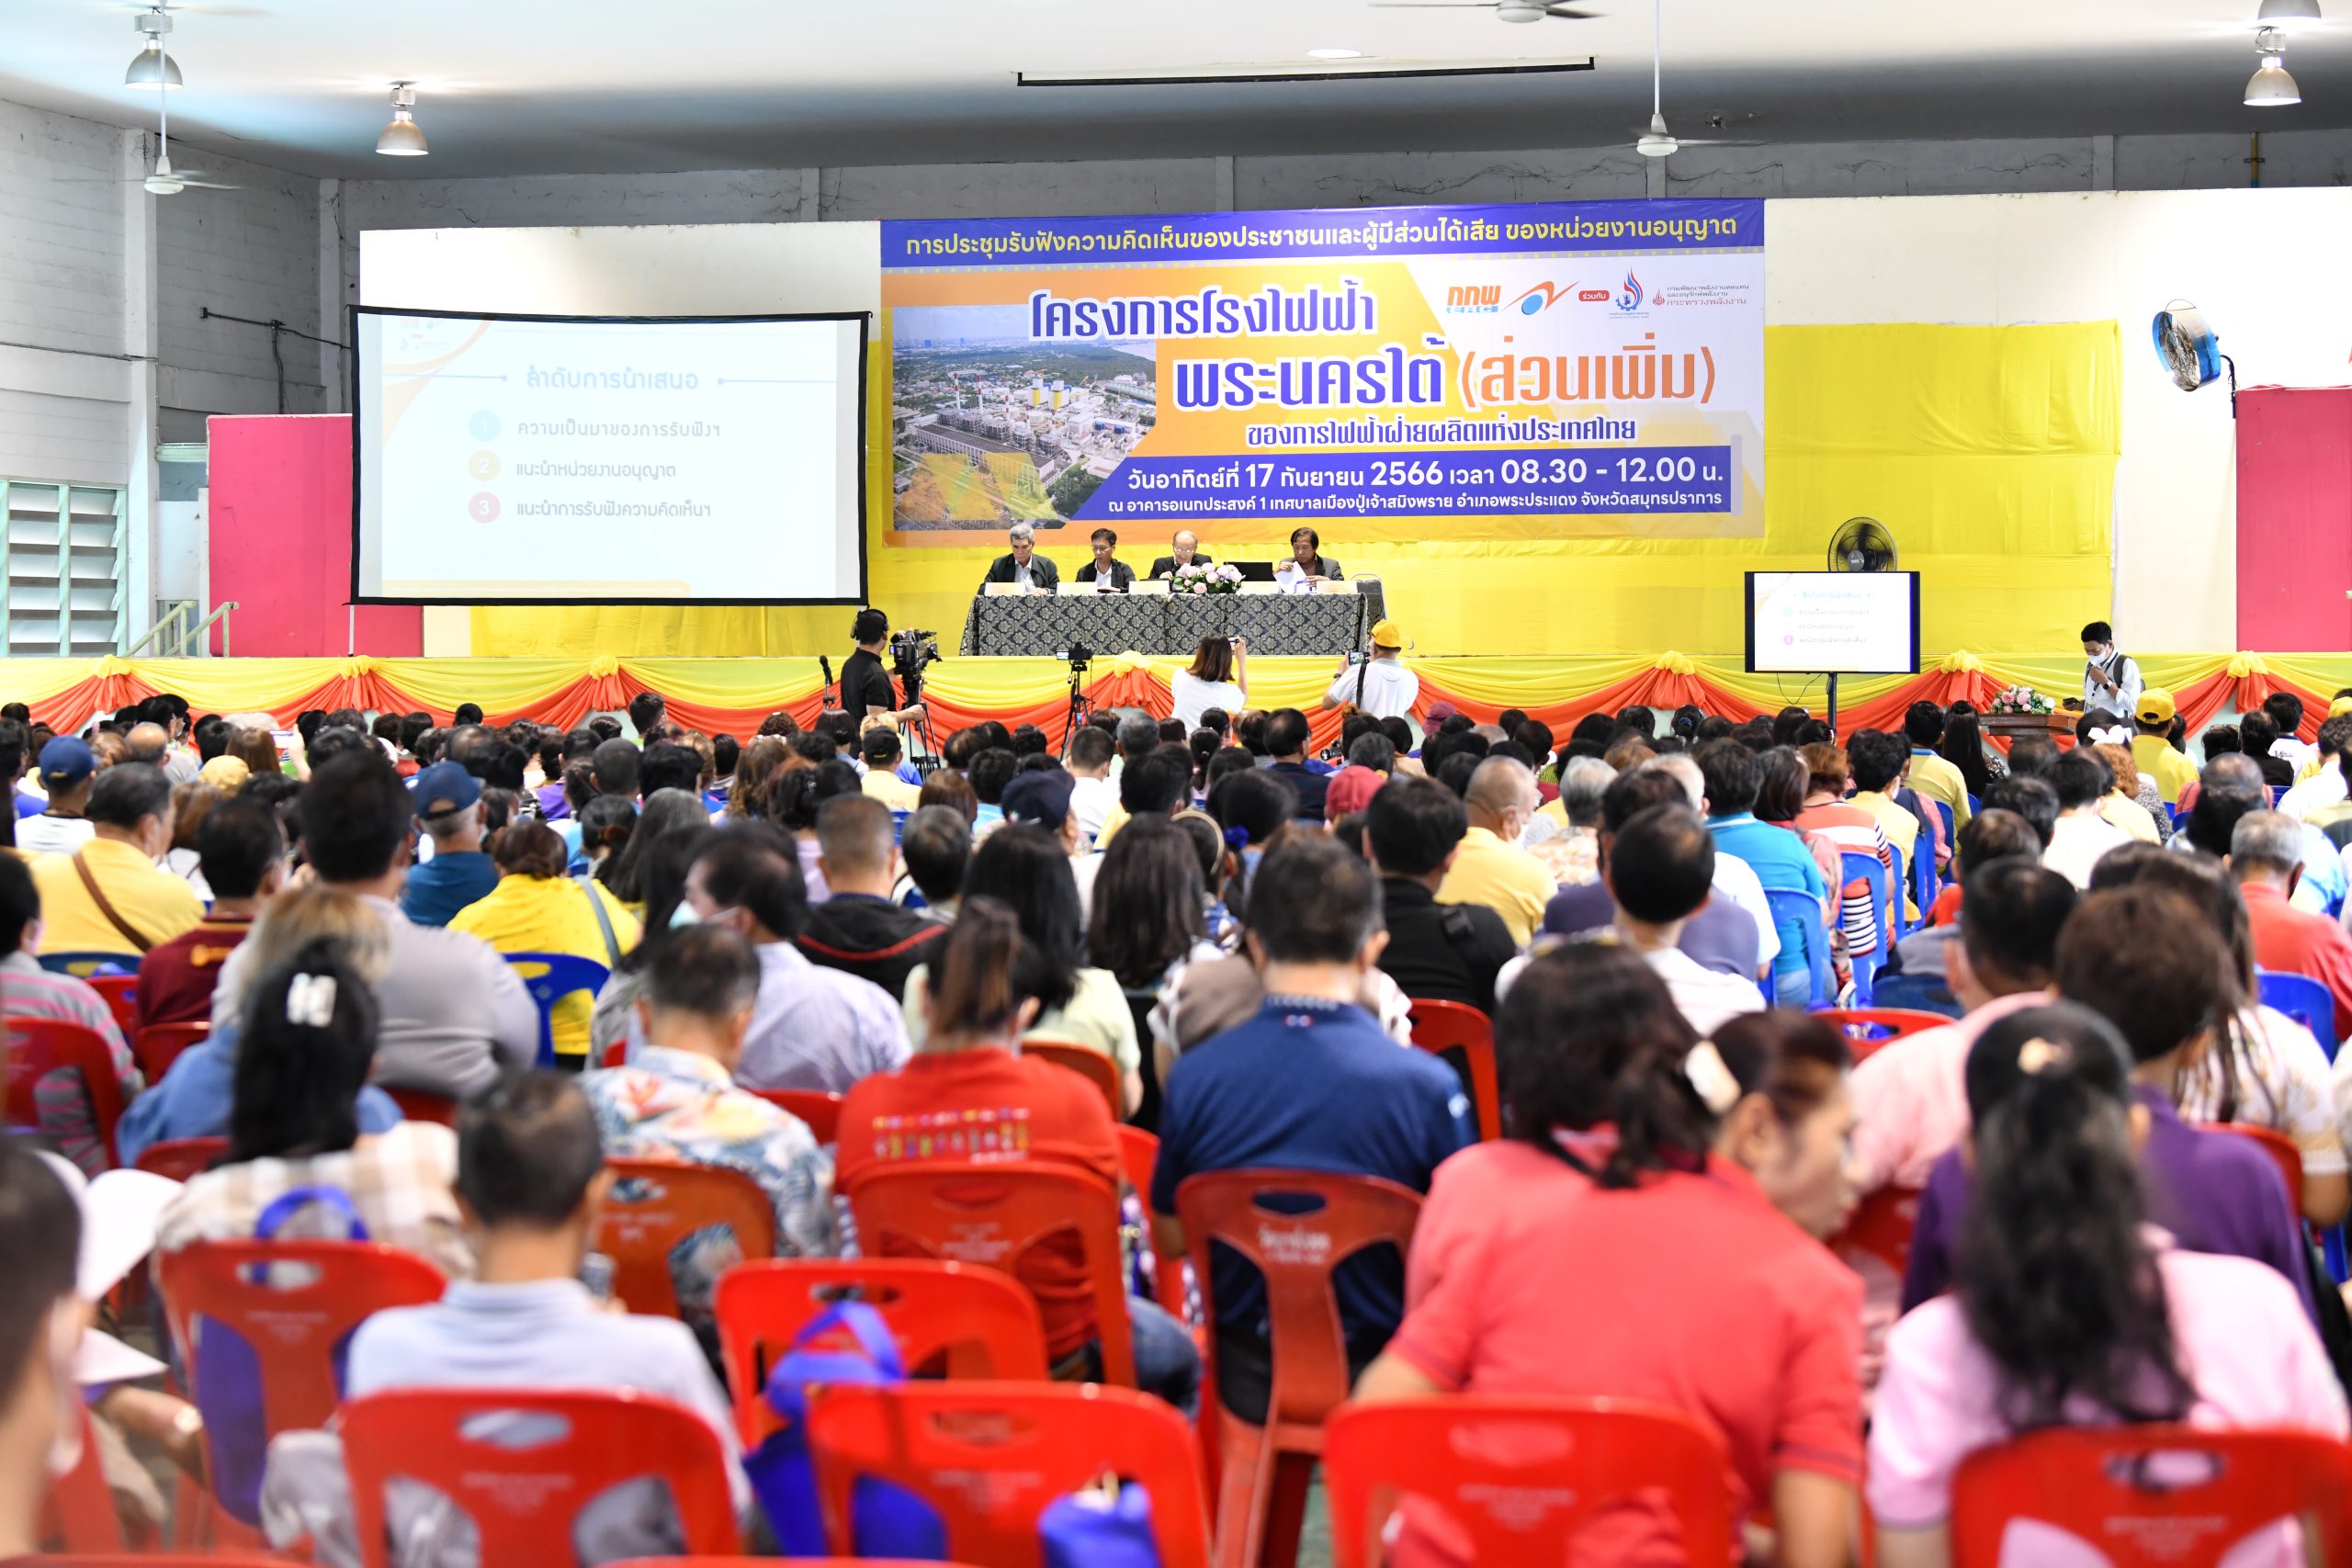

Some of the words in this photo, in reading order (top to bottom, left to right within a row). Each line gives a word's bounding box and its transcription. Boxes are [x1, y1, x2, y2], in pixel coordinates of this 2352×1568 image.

[907, 217, 1499, 260] การประชุมรับฟังความคิดเห็นของประชาชนและผู้มีส่วนได้เสีย
[1506, 216, 1736, 242] ของหน่วยงานอนุญาต
[1032, 279, 1374, 337] โครงการโรงไฟฟ้า
[1447, 285, 1501, 306] กกพ
[1582, 291, 1606, 300] ร่วมกับ
[526, 364, 698, 390] ลำดับการนำเสนอ
[1177, 337, 1445, 407] พระนครใต้
[1462, 332, 1715, 408] (ส่วนเพิ่ม)
[517, 418, 721, 437] ความเป็นมาของการรับฟังฯ
[1248, 413, 1636, 446] ของการไฟฟ้าฝ่ายผลิตแห่งประเทศไทย
[478, 457, 491, 475] 2
[516, 459, 676, 482] แนะนำหน่วยงานอนุญาต
[1128, 461, 1239, 489] วันอาทิตย์ที่
[1245, 463, 1274, 487] 17
[1281, 467, 1363, 487] กันยายน
[1371, 461, 1443, 486] 2566
[1450, 468, 1495, 485] เวลา
[1500, 458, 1588, 484] 08.30
[1615, 457, 1696, 483] 12.00
[1702, 465, 1724, 481] น.
[478, 499, 491, 516] 3
[516, 499, 711, 517] แนะนำการรับฟังความคิดเห็นฯ
[1108, 501, 1124, 513] ณ
[1127, 496, 1256, 512] อาคารอเนกประสงค์
[1260, 496, 1266, 510] 1
[1271, 493, 1453, 513] เทศบาลเมืองปู่เจ้าสมิงพราย
[1457, 491, 1577, 508] อำเภอพระประแดง
[1581, 491, 1722, 509] จังหวัดสมุทรปราการ
